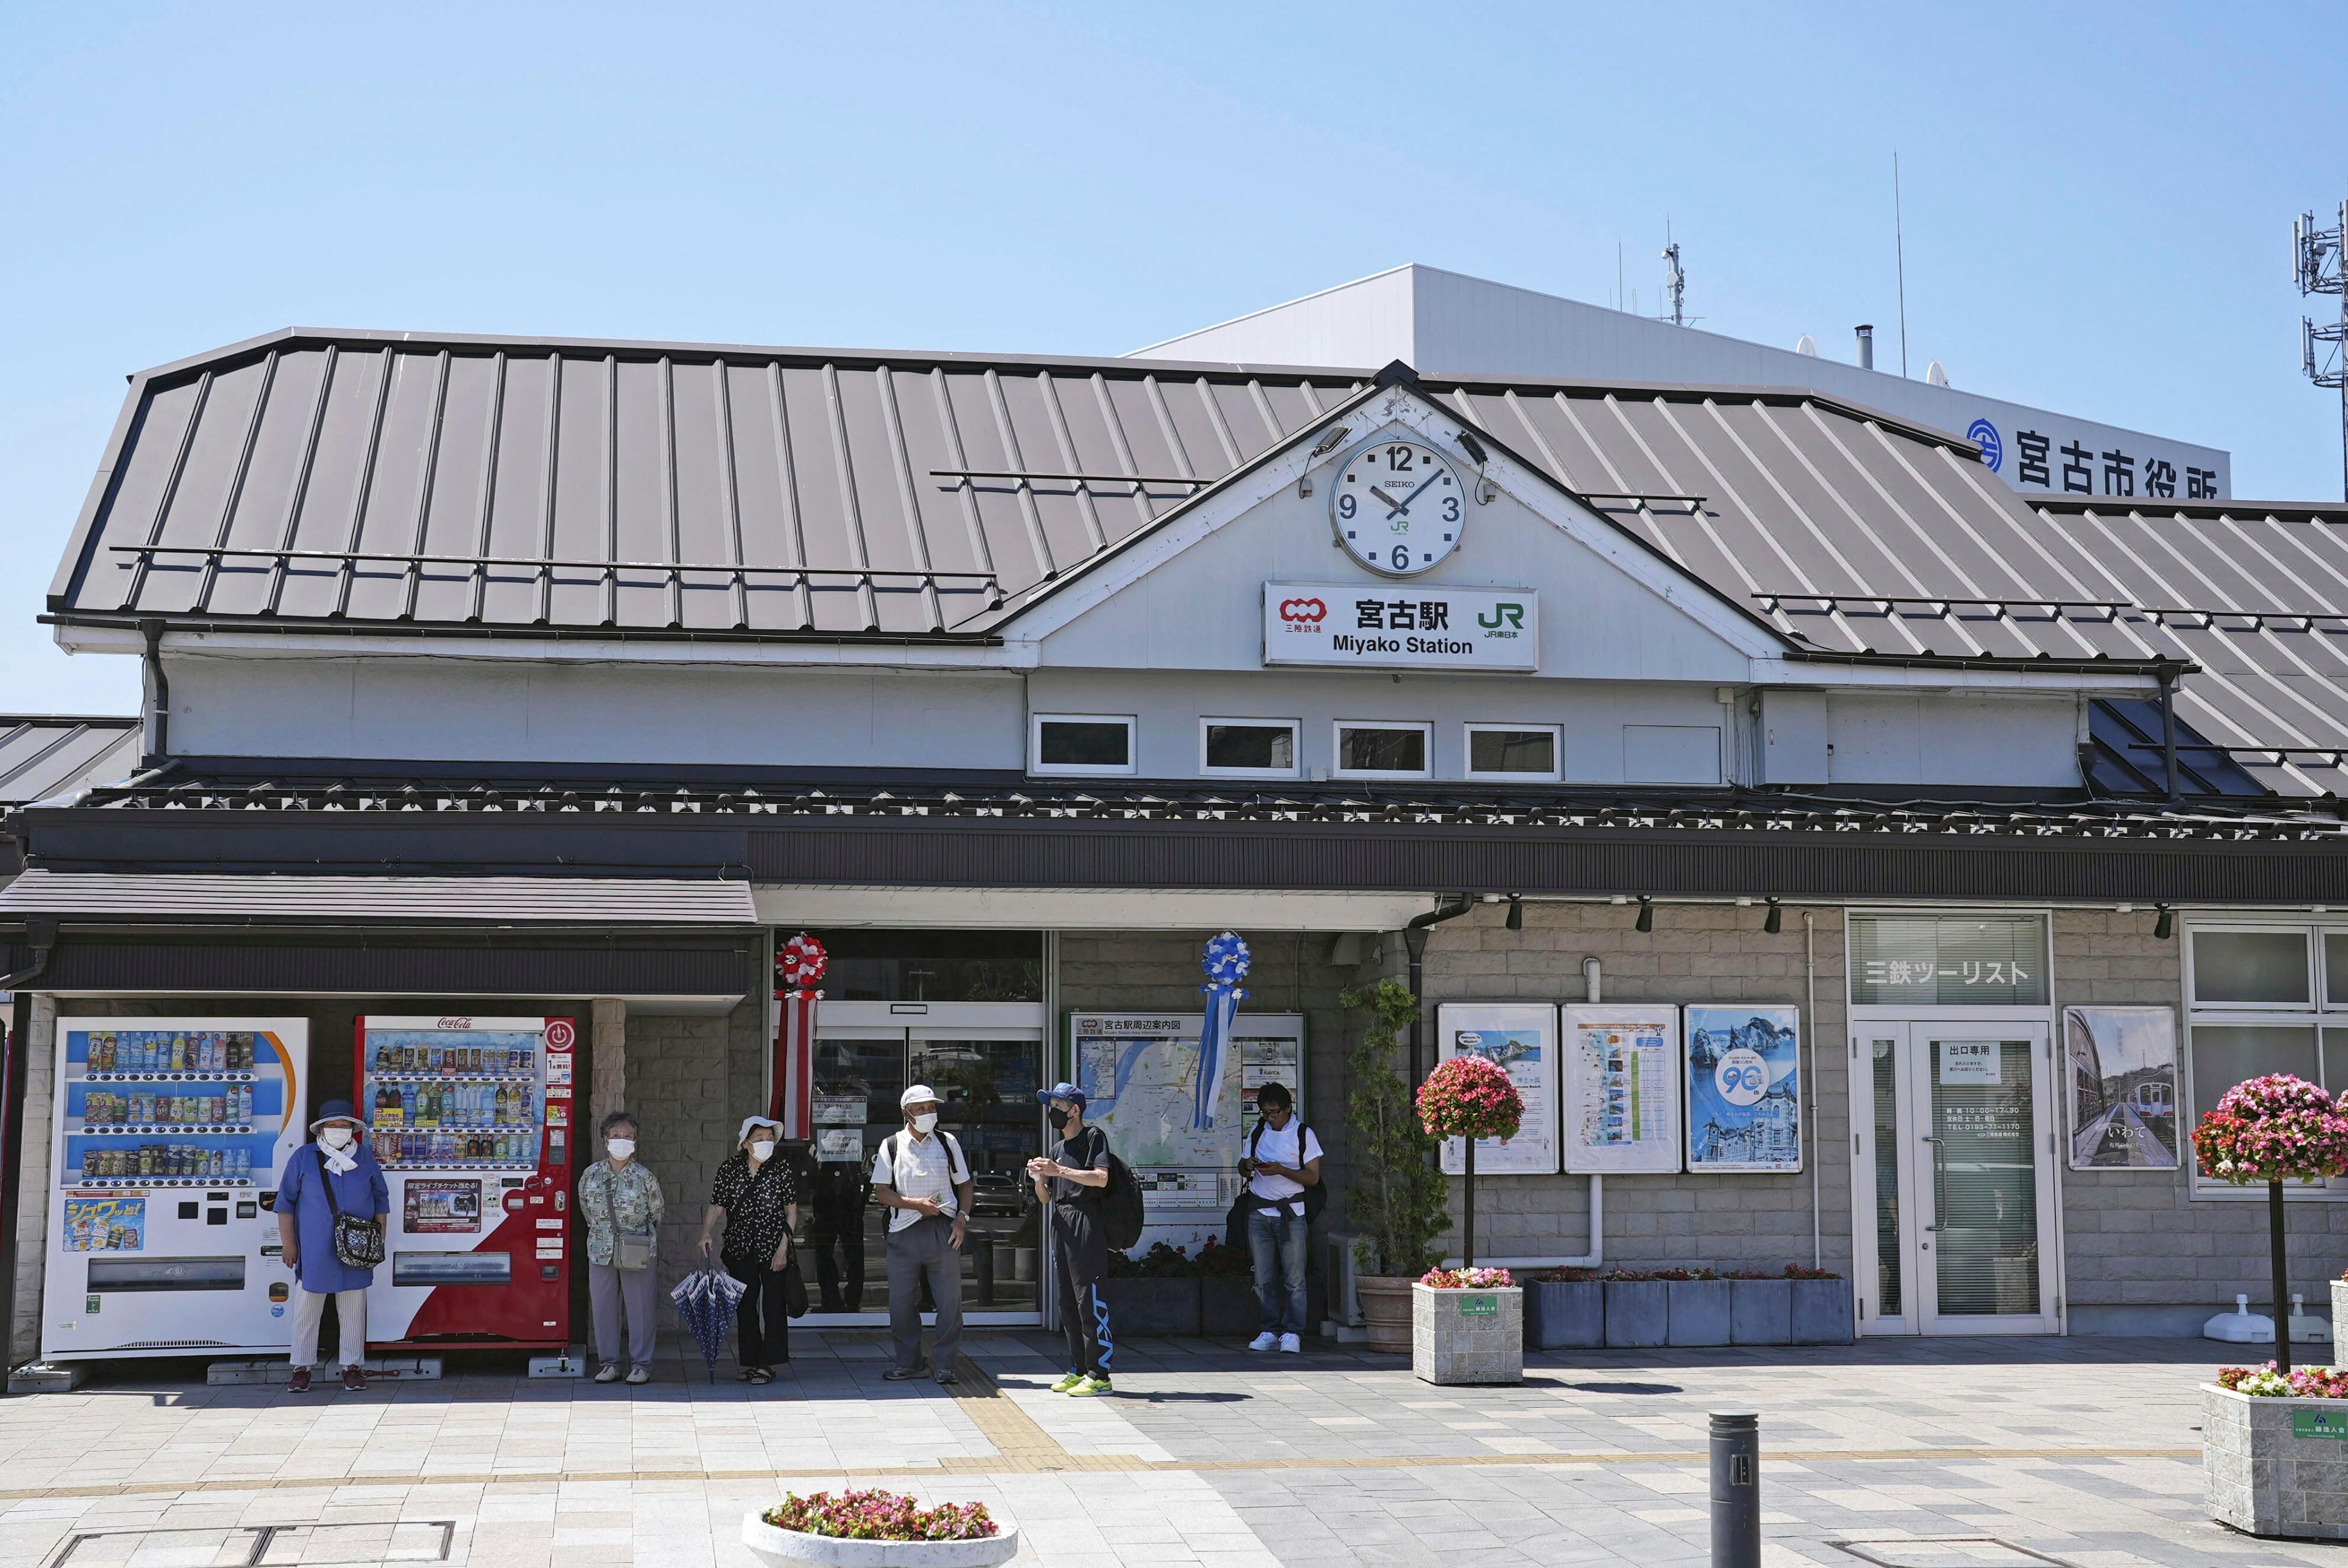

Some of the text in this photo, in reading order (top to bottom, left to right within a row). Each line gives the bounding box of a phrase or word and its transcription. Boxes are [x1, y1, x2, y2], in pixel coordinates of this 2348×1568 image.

[1386, 447, 1412, 471] 12
[2016, 430, 2217, 499] 宮古市役所
[1339, 494, 1357, 519] 9
[1442, 497, 1459, 522] 3
[1390, 521, 1409, 531] JR
[1391, 545, 1409, 570] 6
[1356, 599, 1448, 631] 宮古駅
[1478, 603, 1524, 629] JR
[1285, 624, 1321, 633] 三陸鉄道
[1333, 635, 1473, 655] Miyako Station
[1865, 960, 2028, 985] 三鉄ツーリスト
[1950, 1045, 1989, 1056] 出口専用
[2108, 1126, 2146, 1138] いわて
